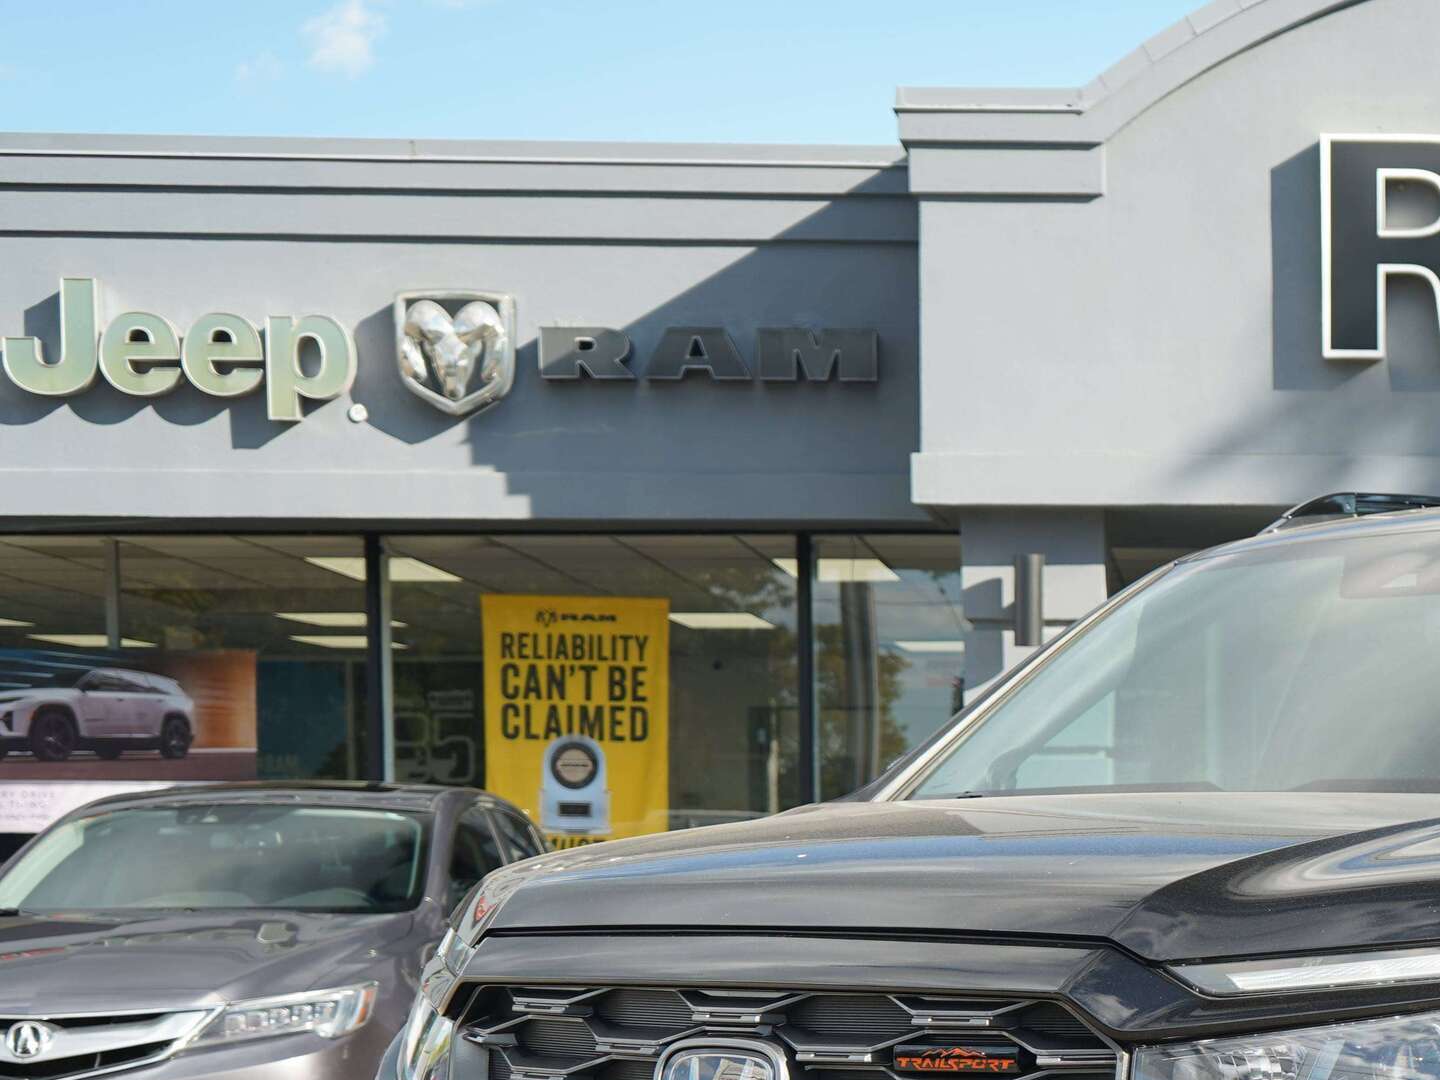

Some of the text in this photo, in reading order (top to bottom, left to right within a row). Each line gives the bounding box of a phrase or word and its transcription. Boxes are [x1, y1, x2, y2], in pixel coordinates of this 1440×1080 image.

[1, 277, 358, 421] Jeep
[538, 326, 879, 382] RAM
[500, 632, 649, 661] RELIABILITY
[500, 663, 598, 701] CAN'T
[608, 666, 648, 702] BE
[501, 703, 649, 742] CLAIMED
[896, 1057, 1016, 1072] TRAILSPORT
